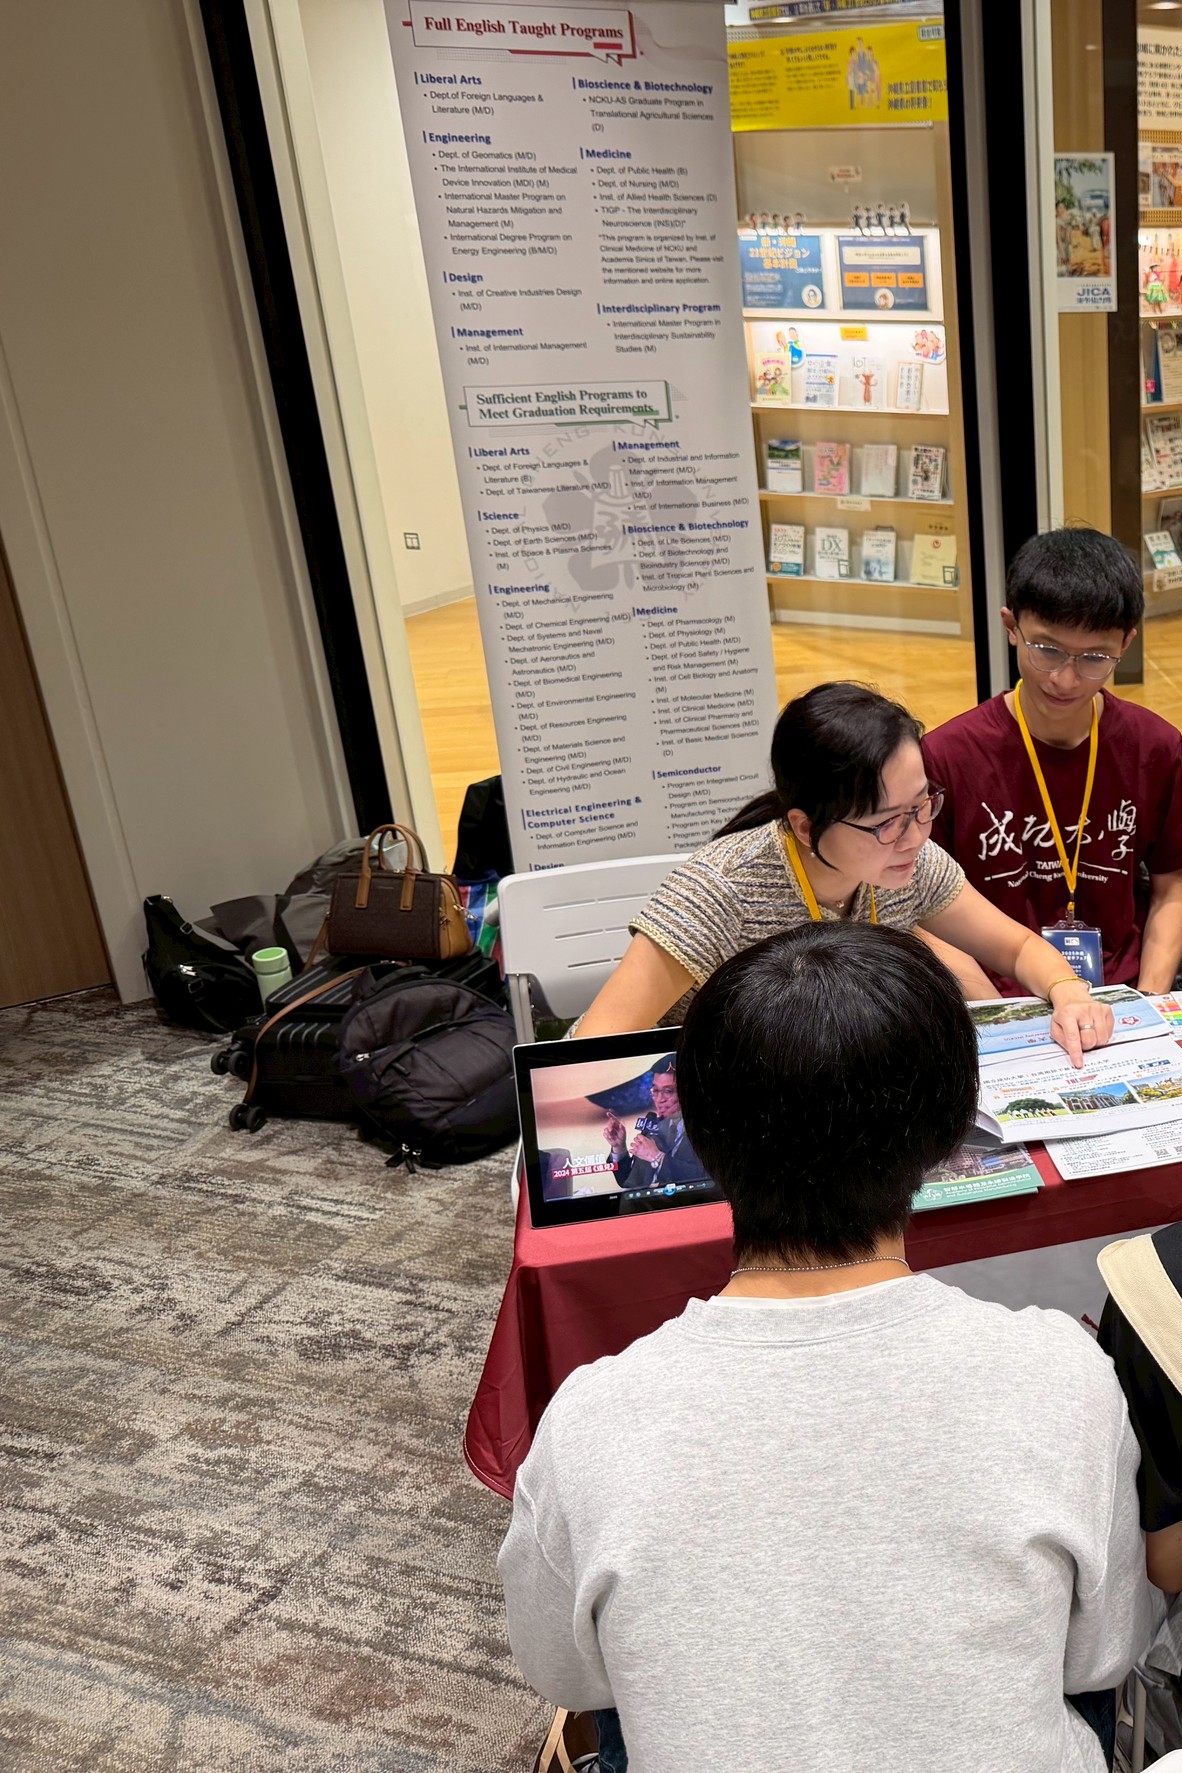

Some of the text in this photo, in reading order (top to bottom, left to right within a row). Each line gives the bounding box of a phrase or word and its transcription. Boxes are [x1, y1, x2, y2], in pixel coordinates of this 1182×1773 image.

[424, 16, 623, 39] Full English Taught Programs
[420, 73, 482, 85] Liberal Arts
[578, 79, 713, 95] Bioscience & Biotechnology
[429, 132, 491, 145] Engineering
[586, 149, 632, 159] Medicine
[449, 272, 484, 284] Design
[1076, 288, 1111, 296] JICA
[602, 303, 721, 314] Interdisciplinary Program
[457, 328, 524, 338] Management
[476, 389, 647, 405] Sufficient English Programs to
[479, 404, 654, 419] Meet Graduation Requirements
[618, 440, 680, 451] Management
[474, 447, 530, 457] Liberal Arts
[482, 512, 519, 520] Science
[628, 519, 749, 534] Bioscience & Biotechnology
[820, 538, 842, 552] DX
[493, 584, 550, 595] Engineering
[636, 606, 678, 615] Medicine
[657, 766, 721, 778] Semiconductor
[525, 805, 571, 817] Electrical
[574, 798, 631, 812] Engineering
[527, 812, 615, 829] Computer Science
[1077, 872, 1109, 883] niversity
[553, 1169, 570, 1178] 2024
